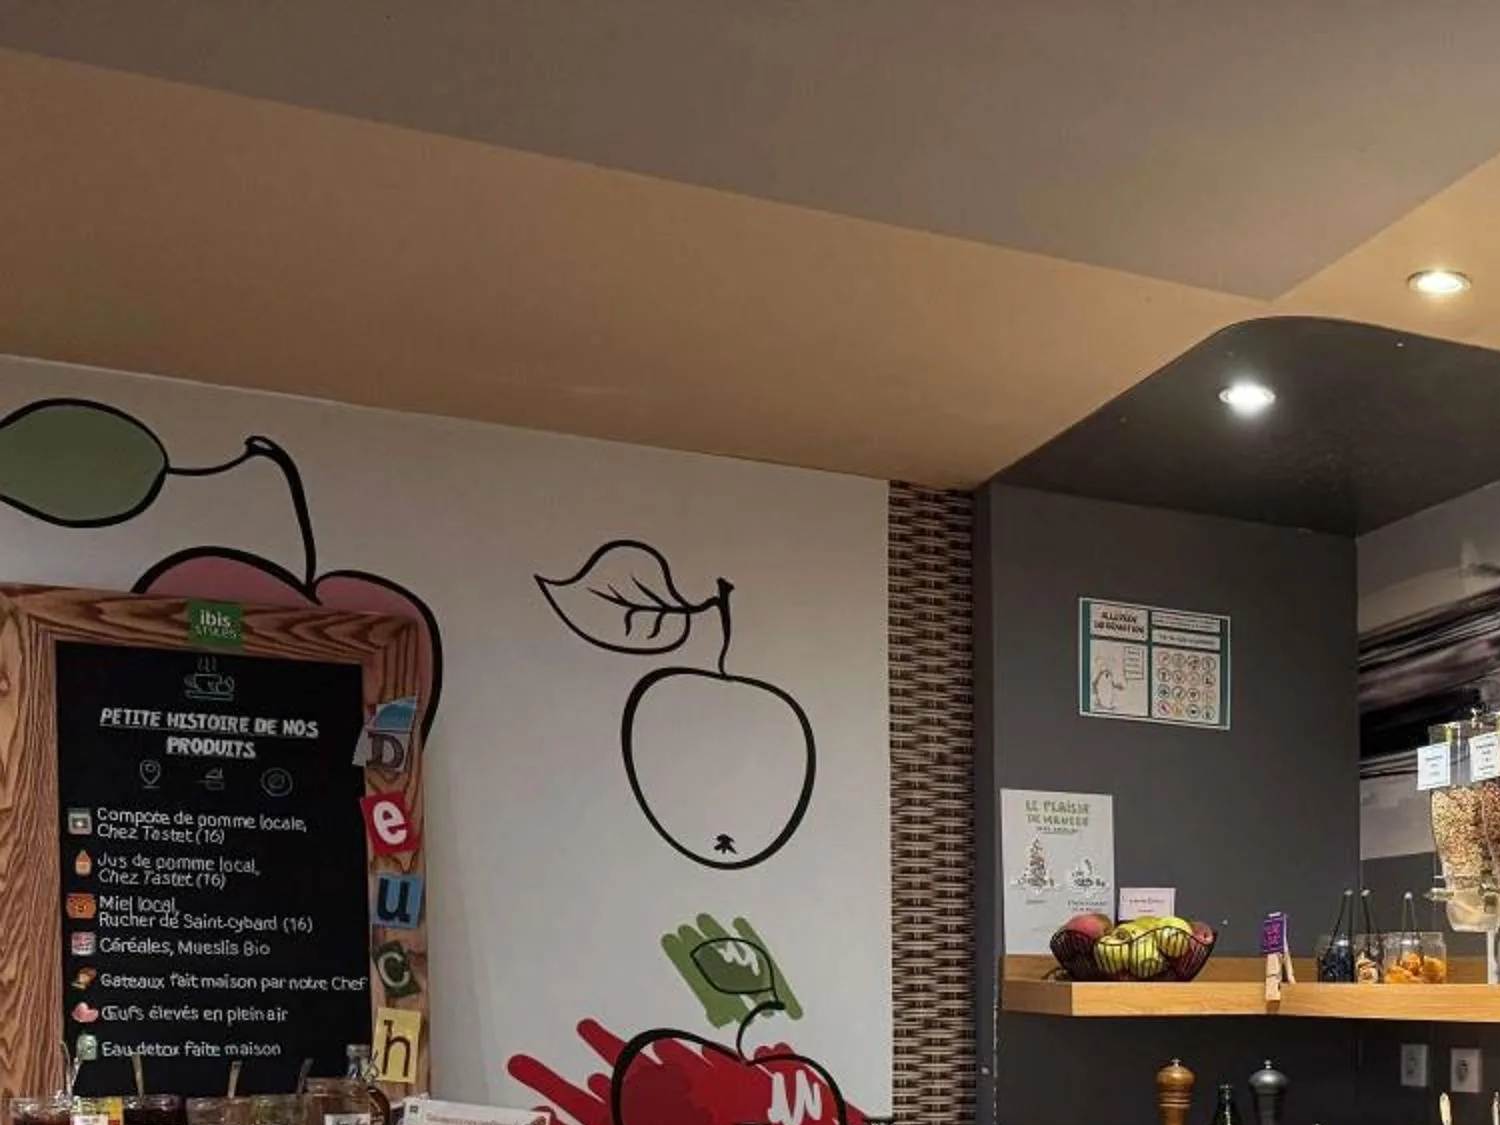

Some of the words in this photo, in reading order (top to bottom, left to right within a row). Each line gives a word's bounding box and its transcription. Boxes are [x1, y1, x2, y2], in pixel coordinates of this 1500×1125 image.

[201, 609, 231, 628] ibis
[100, 707, 162, 728] PETITE
[168, 712, 249, 733] HISTOIRE
[254, 717, 279, 735] DE
[283, 720, 319, 739] NOS
[166, 736, 257, 759] PRODUITS
[97, 807, 171, 827] Compote
[173, 810, 194, 825] de
[200, 814, 255, 831] pomme
[97, 824, 139, 839] Chez
[196, 829, 225, 844] (16)
[98, 851, 128, 868] Jus
[132, 853, 151, 869] de
[156, 856, 215, 873] pomme
[99, 869, 139, 885] Chez
[197, 873, 227, 889] (16)
[99, 895, 133, 912] Miel
[99, 912, 156, 928] Rucher
[159, 912, 178, 928] de
[283, 916, 313, 934] (16)
[99, 937, 174, 957] Céréales,
[178, 939, 239, 955] Mueslis
[243, 940, 271, 957] Bio
[170, 972, 199, 989] fait
[201, 971, 257, 989] maison
[261, 976, 287, 993] par
[289, 976, 328, 991] notre
[332, 976, 368, 991] Chef
[203, 1008, 223, 1022] en
[227, 1006, 264, 1027] plein
[266, 1007, 289, 1023] air
[102, 1041, 132, 1056] Eau
[184, 1040, 221, 1056] faite
[224, 1041, 282, 1056] maison
